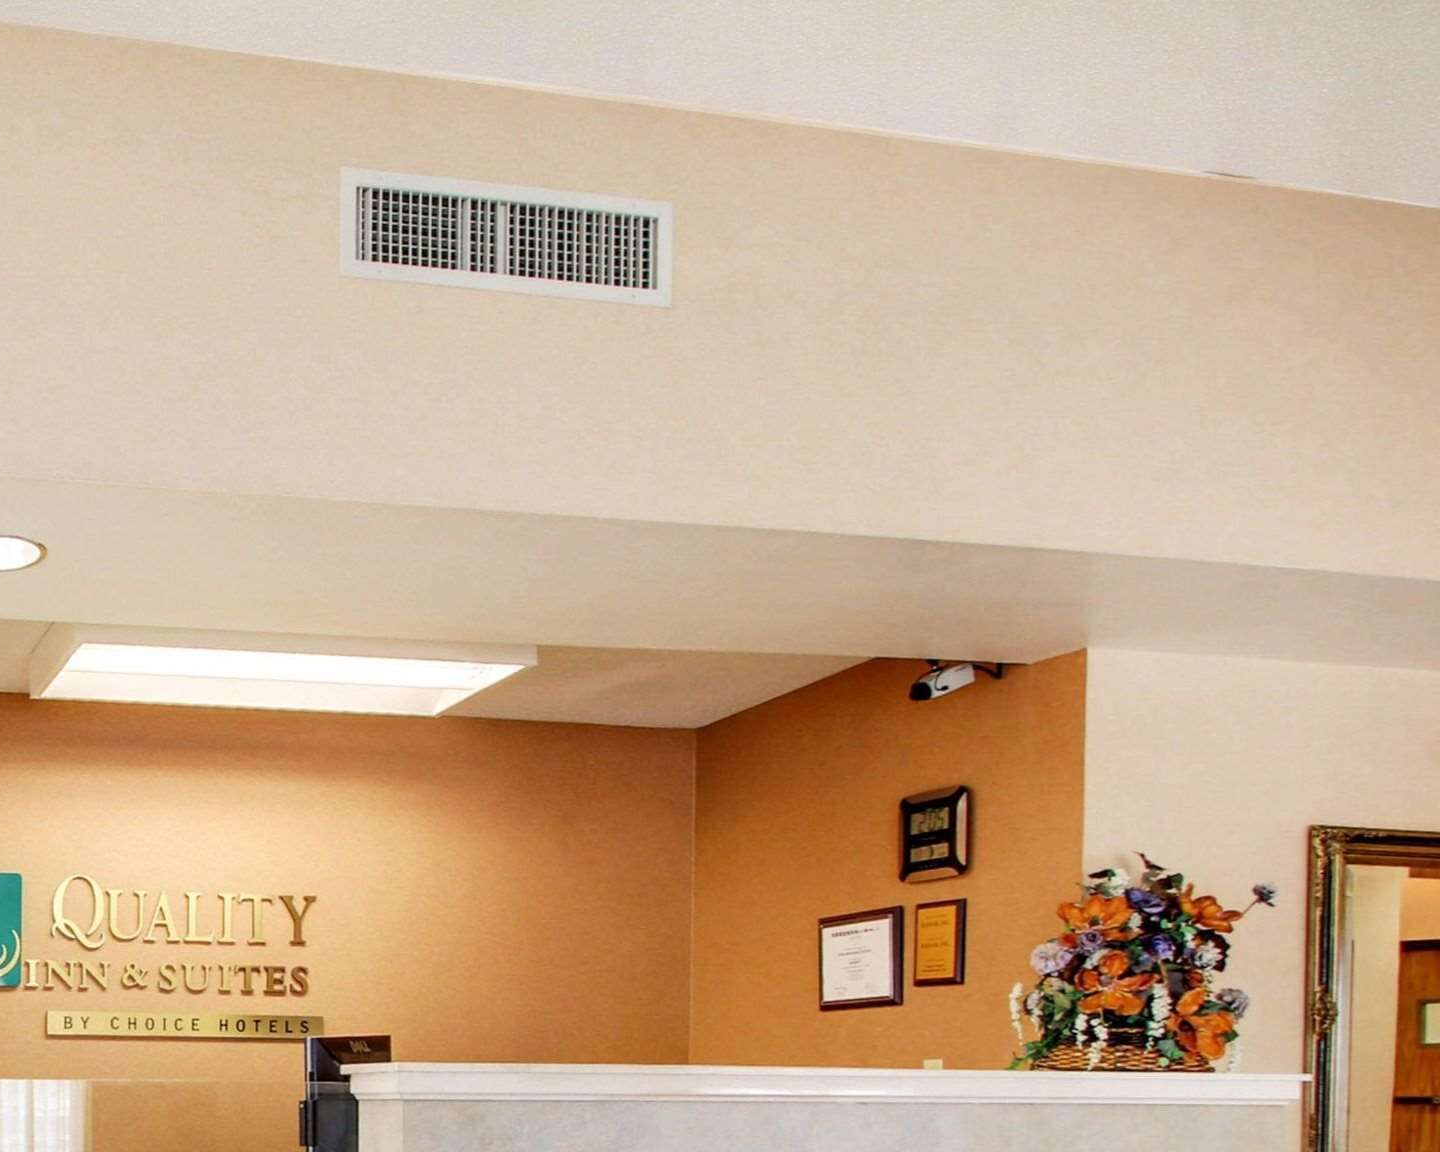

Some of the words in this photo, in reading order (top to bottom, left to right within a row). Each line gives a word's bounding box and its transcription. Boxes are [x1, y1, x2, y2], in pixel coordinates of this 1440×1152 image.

[50, 873, 317, 950] QUALITY
[23, 958, 111, 992] INN
[120, 959, 149, 990] &
[156, 962, 310, 997] SUITES
[63, 1015, 91, 1030] BY
[110, 1016, 201, 1032] CHOICE
[218, 1018, 311, 1035] HOTELS
